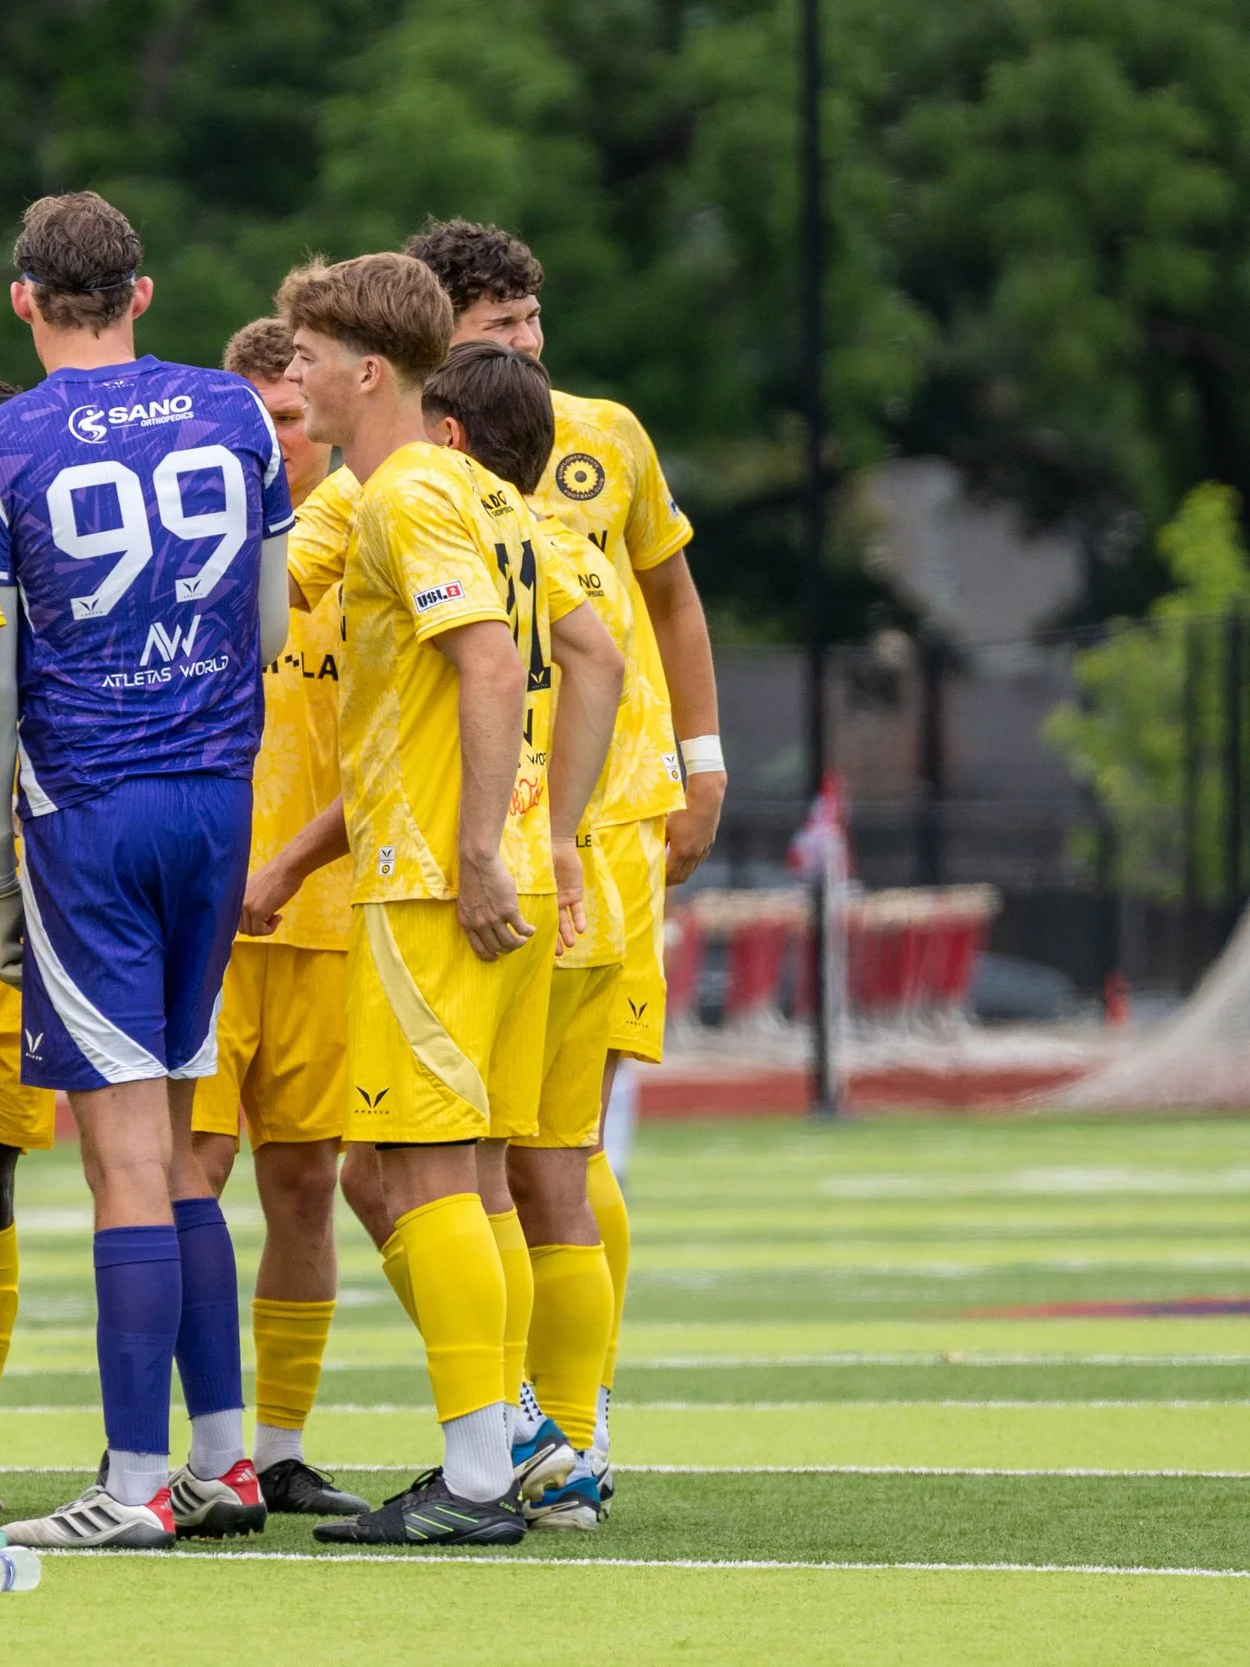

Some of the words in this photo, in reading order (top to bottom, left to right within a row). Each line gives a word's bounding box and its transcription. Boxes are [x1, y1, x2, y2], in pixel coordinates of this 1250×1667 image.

[108, 395, 193, 424] SANO
[140, 411, 194, 427] ORTHOPEDICS
[46, 444, 247, 621] 99
[578, 573, 601, 589] NO
[416, 589, 448, 608] USL
[102, 667, 172, 687] ATLETAS
[179, 655, 229, 678] WORLD
